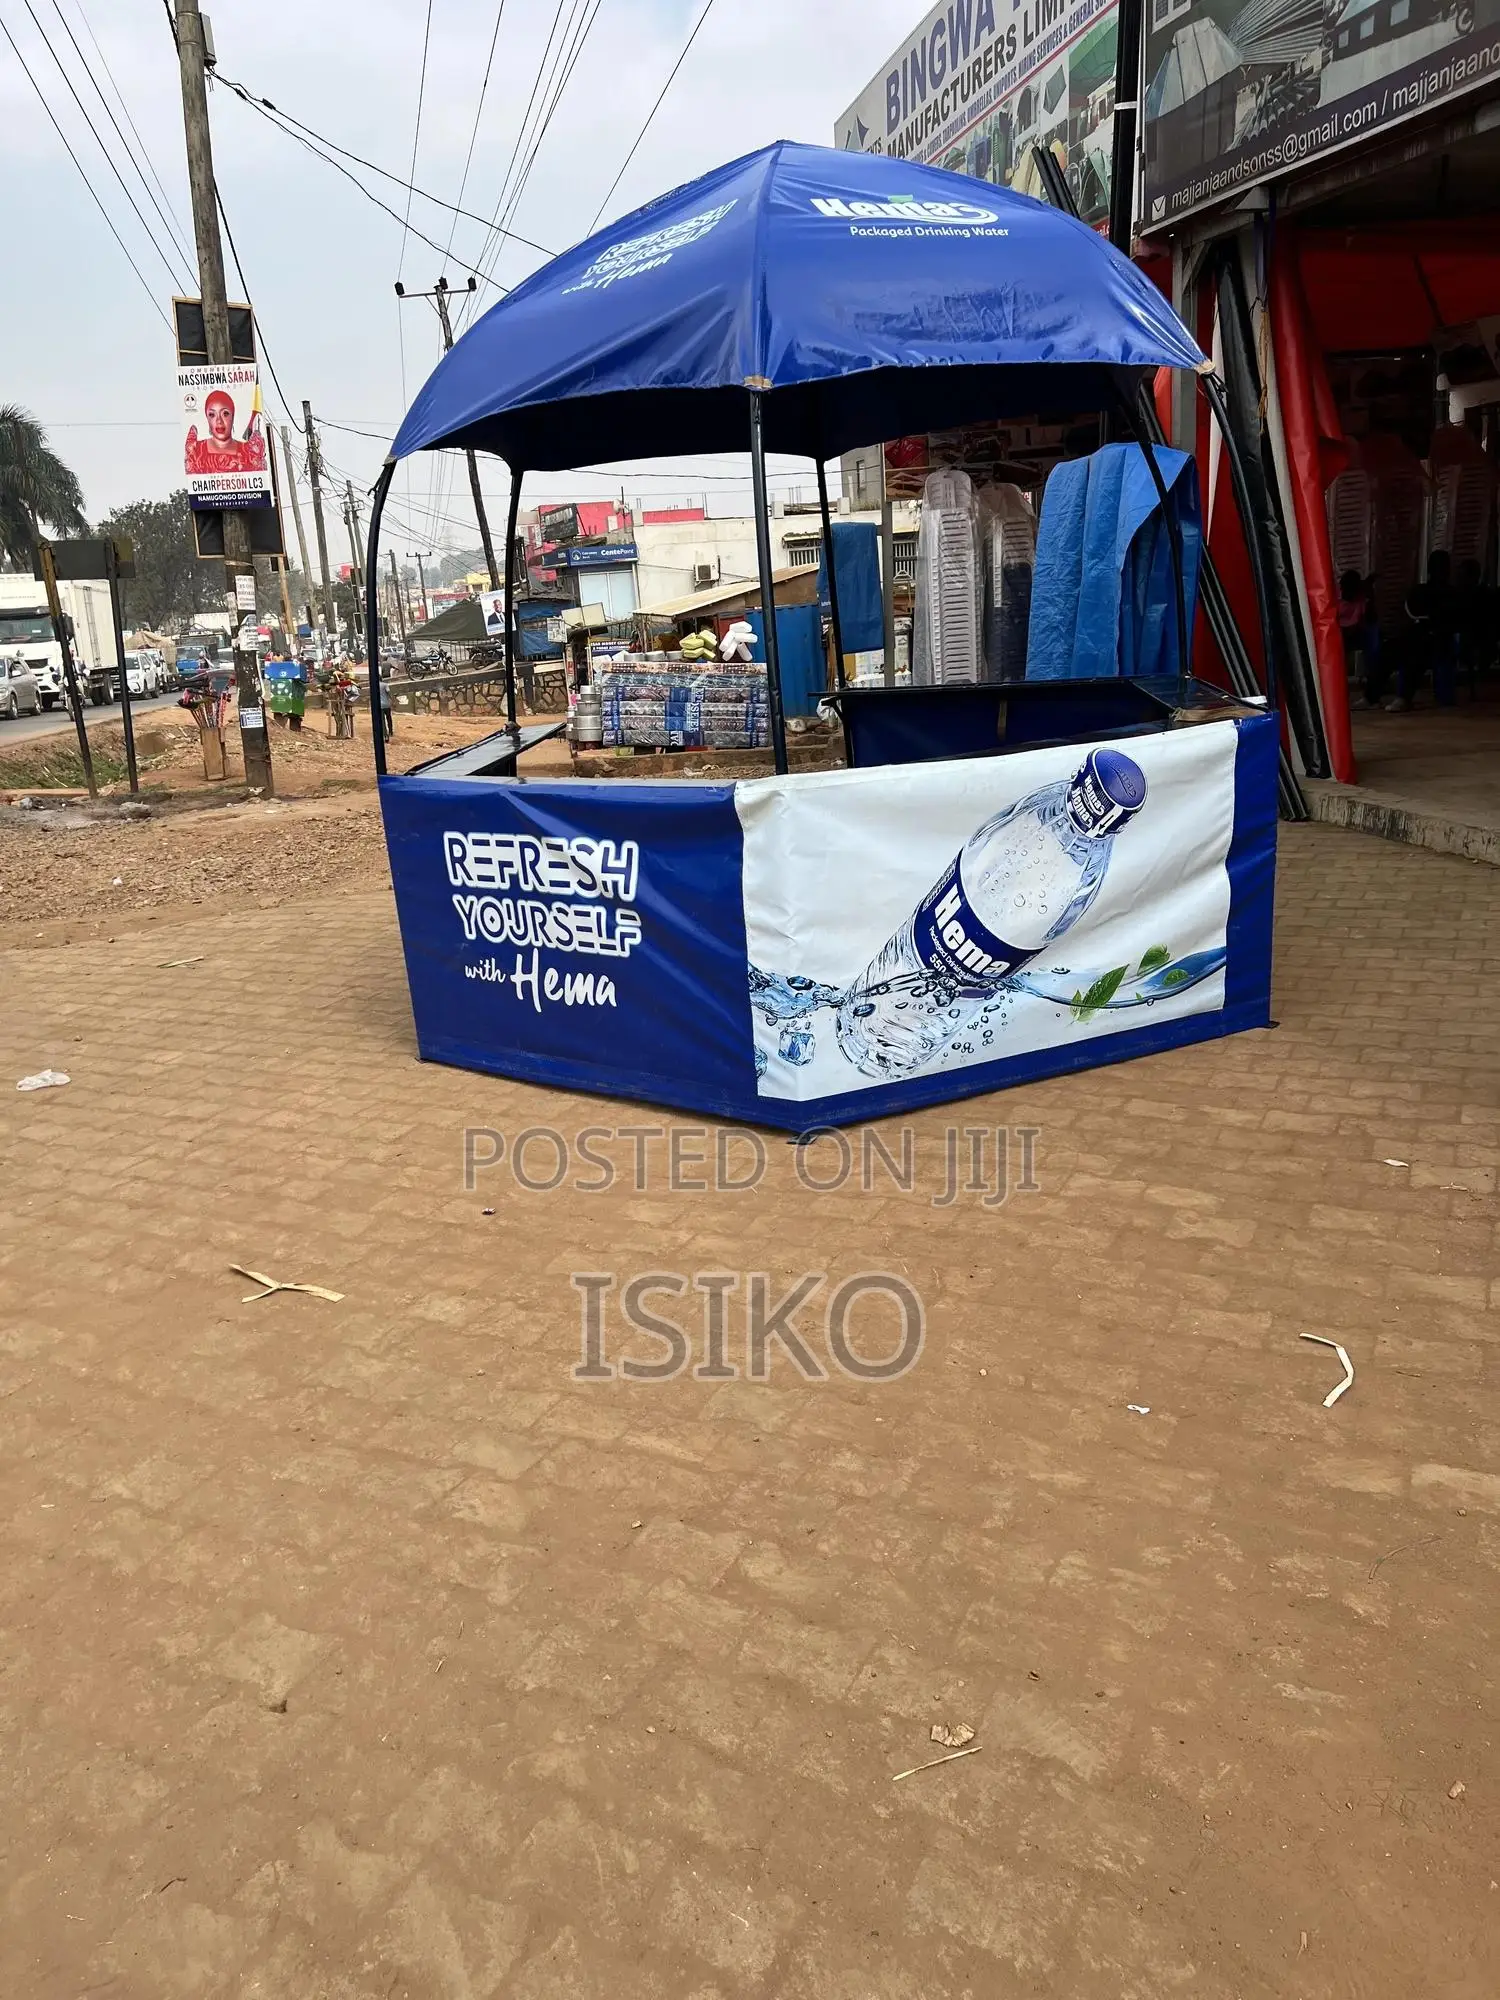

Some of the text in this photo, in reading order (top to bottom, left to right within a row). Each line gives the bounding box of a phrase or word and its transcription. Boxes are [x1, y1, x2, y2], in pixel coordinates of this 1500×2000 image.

[886, 0, 995, 136] BINGWA
[888, 24, 1017, 159] MANUFACTURERS
[1172, 102, 1377, 208] majjanjaandsonss@gmail.com
[850, 226, 1009, 238] Packaged Drinking Water
[178, 370, 255, 387] NASSIMBWA SARAH
[192, 477, 264, 492] CHAIRPERSON LC3
[197, 492, 262, 502] NAMUGONGO DIVISION
[443, 831, 639, 901] REFRESH
[452, 894, 642, 958] YOURSELF
[934, 883, 1011, 978] Hema
[465, 948, 617, 1013] with Hema
